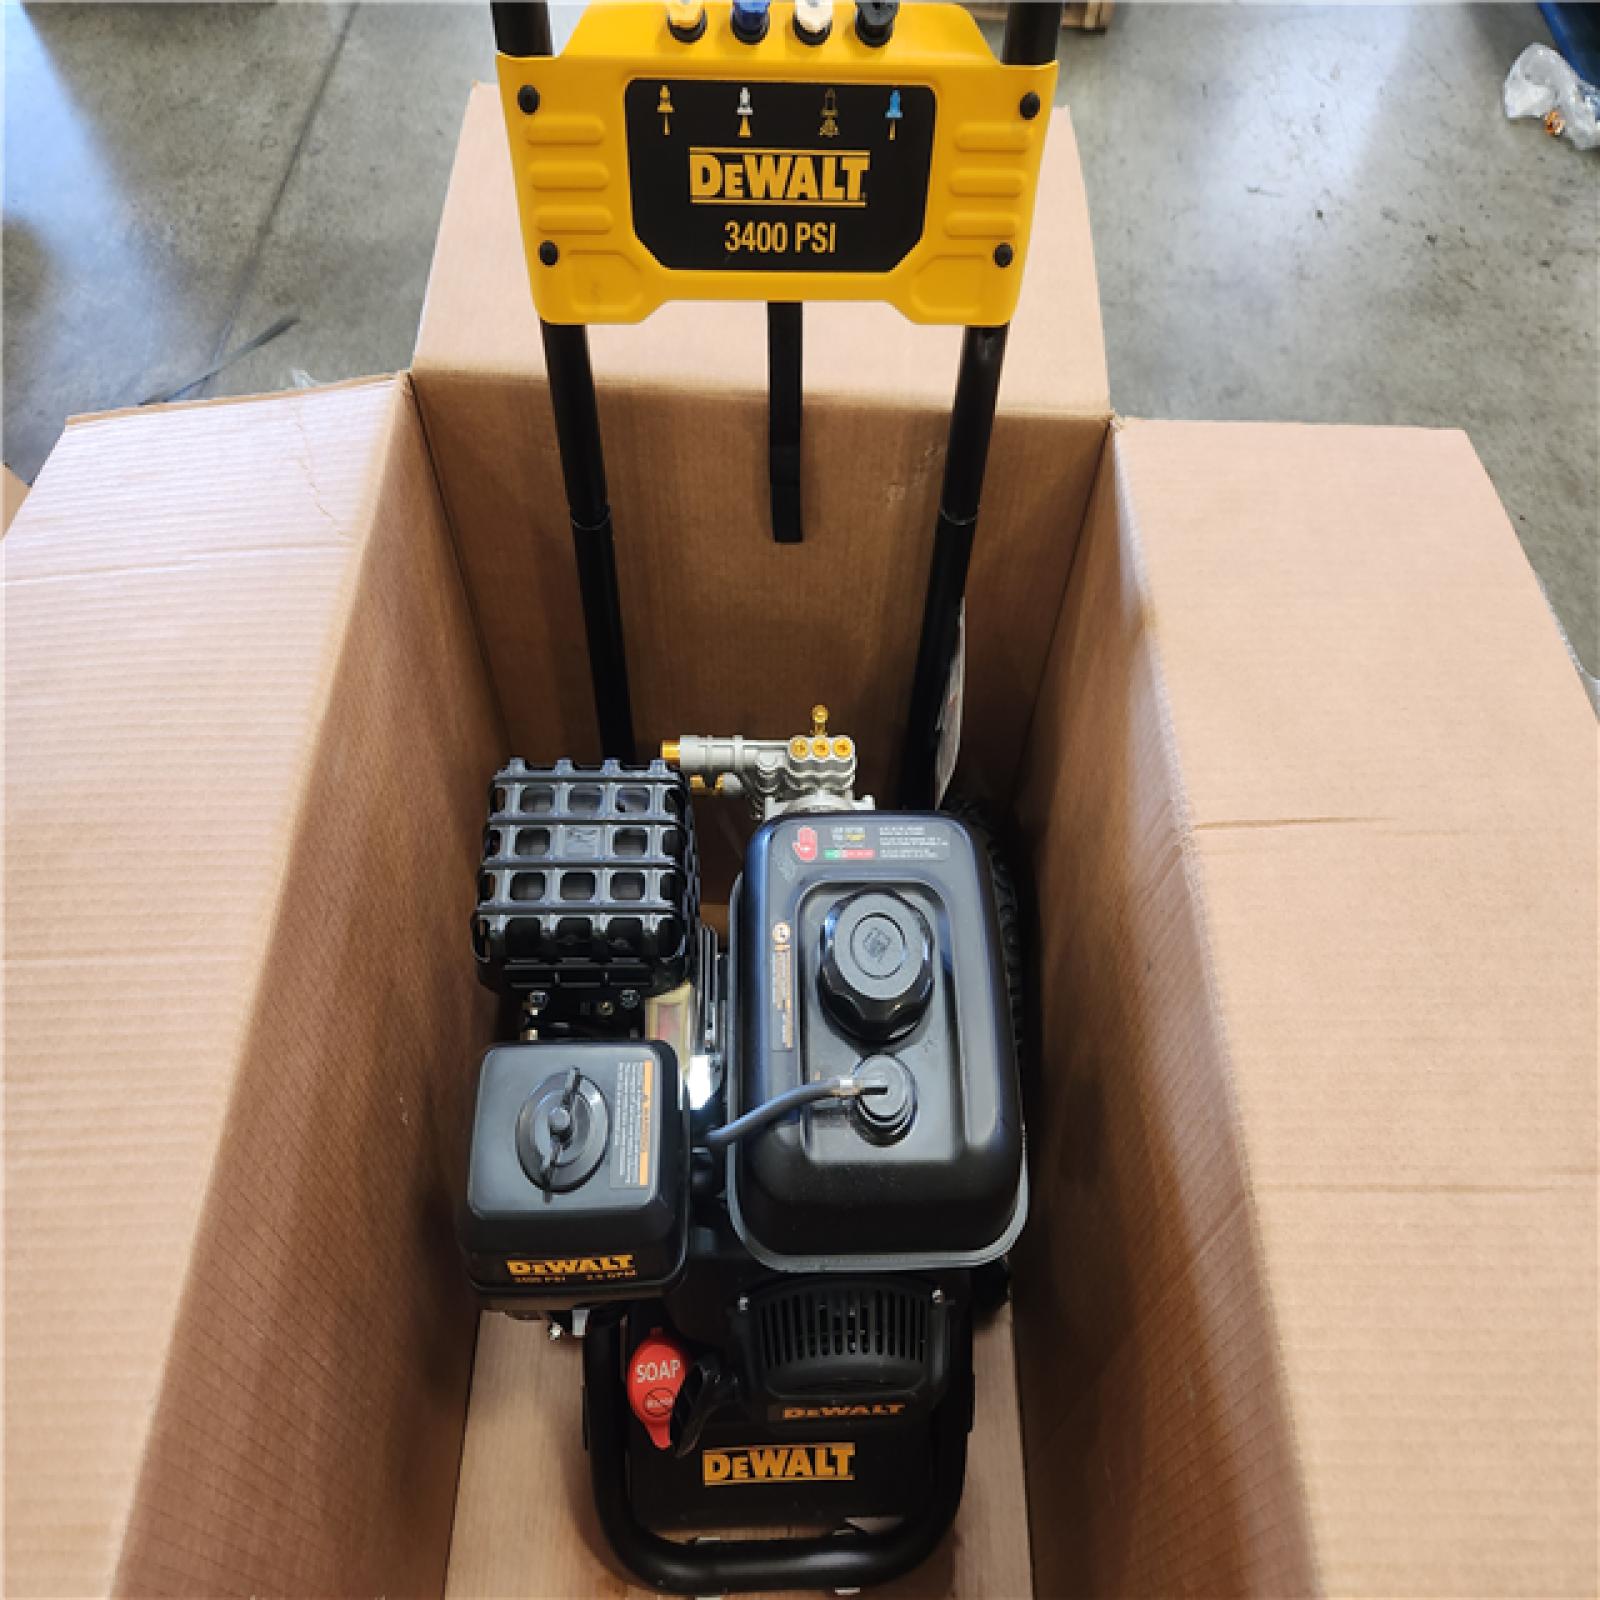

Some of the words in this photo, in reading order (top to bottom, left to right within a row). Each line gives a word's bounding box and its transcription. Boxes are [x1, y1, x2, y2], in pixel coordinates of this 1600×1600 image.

[724, 221, 788, 253] 3400
[794, 222, 836, 253] PSI
[636, 1360, 681, 1384] SOAP
